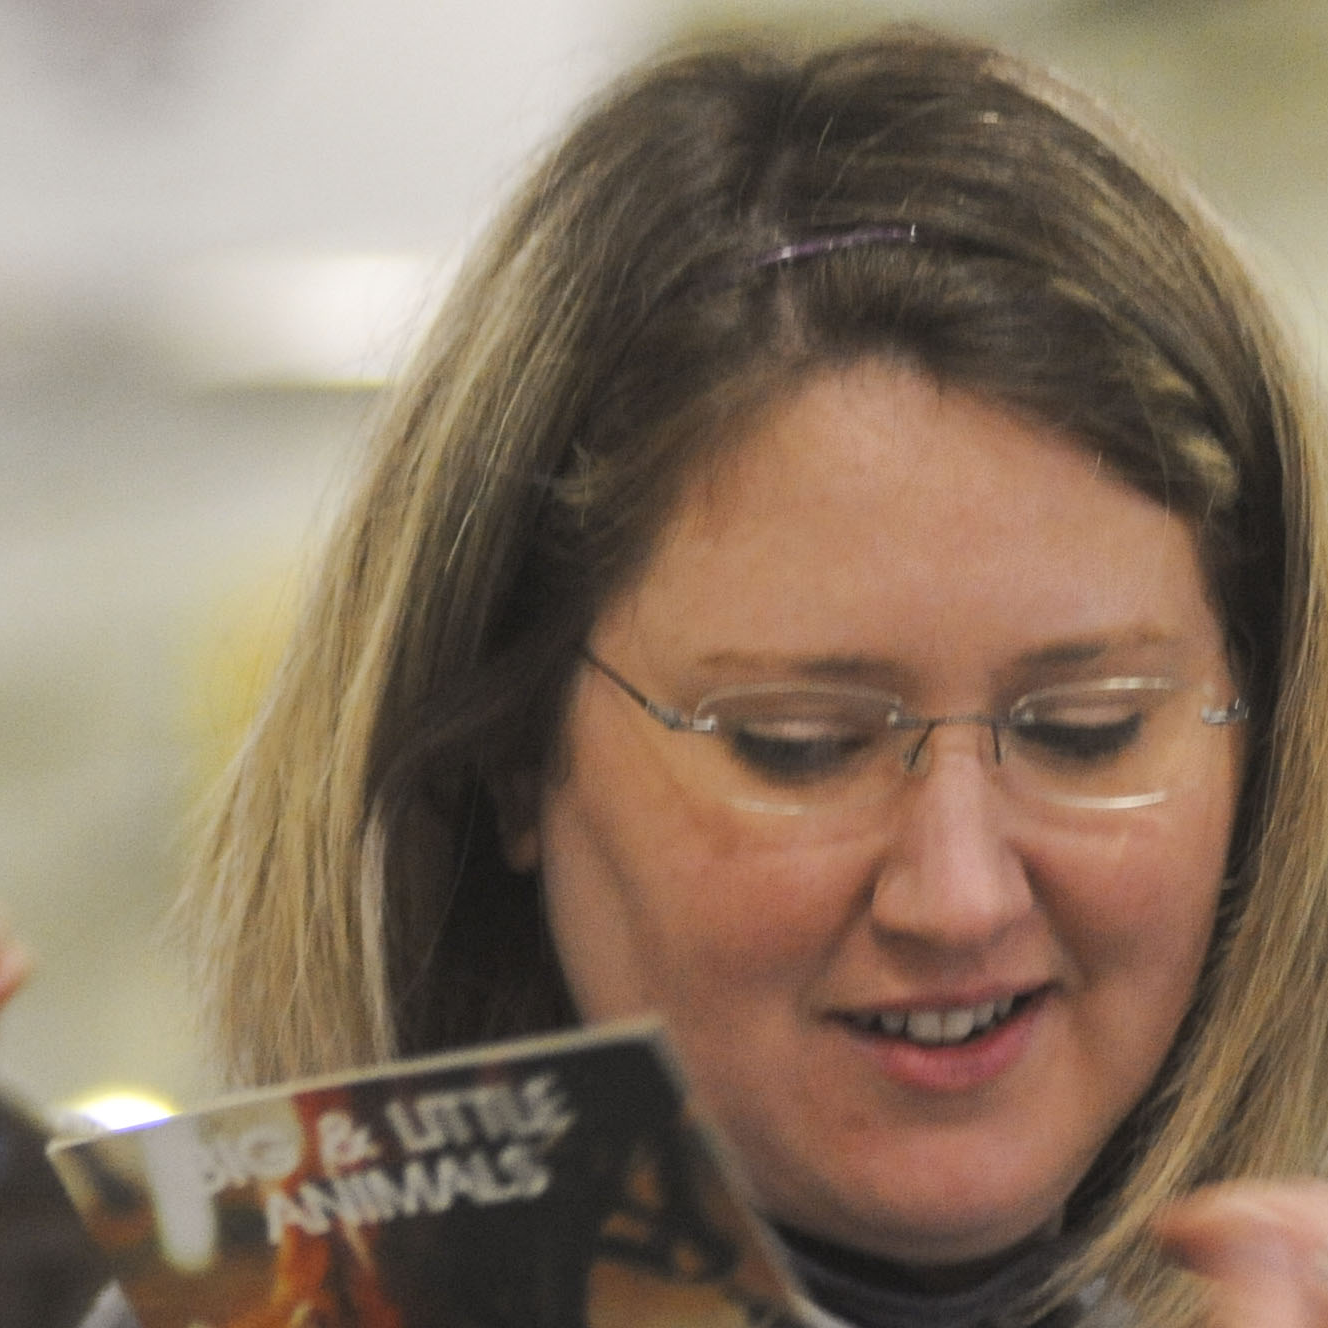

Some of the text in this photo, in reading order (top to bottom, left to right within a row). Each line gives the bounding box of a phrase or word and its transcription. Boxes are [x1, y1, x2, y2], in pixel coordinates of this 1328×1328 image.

[319, 1110, 379, 1168] &
[385, 1073, 576, 1152] LITTLE
[267, 1143, 551, 1246] ANIMALS
